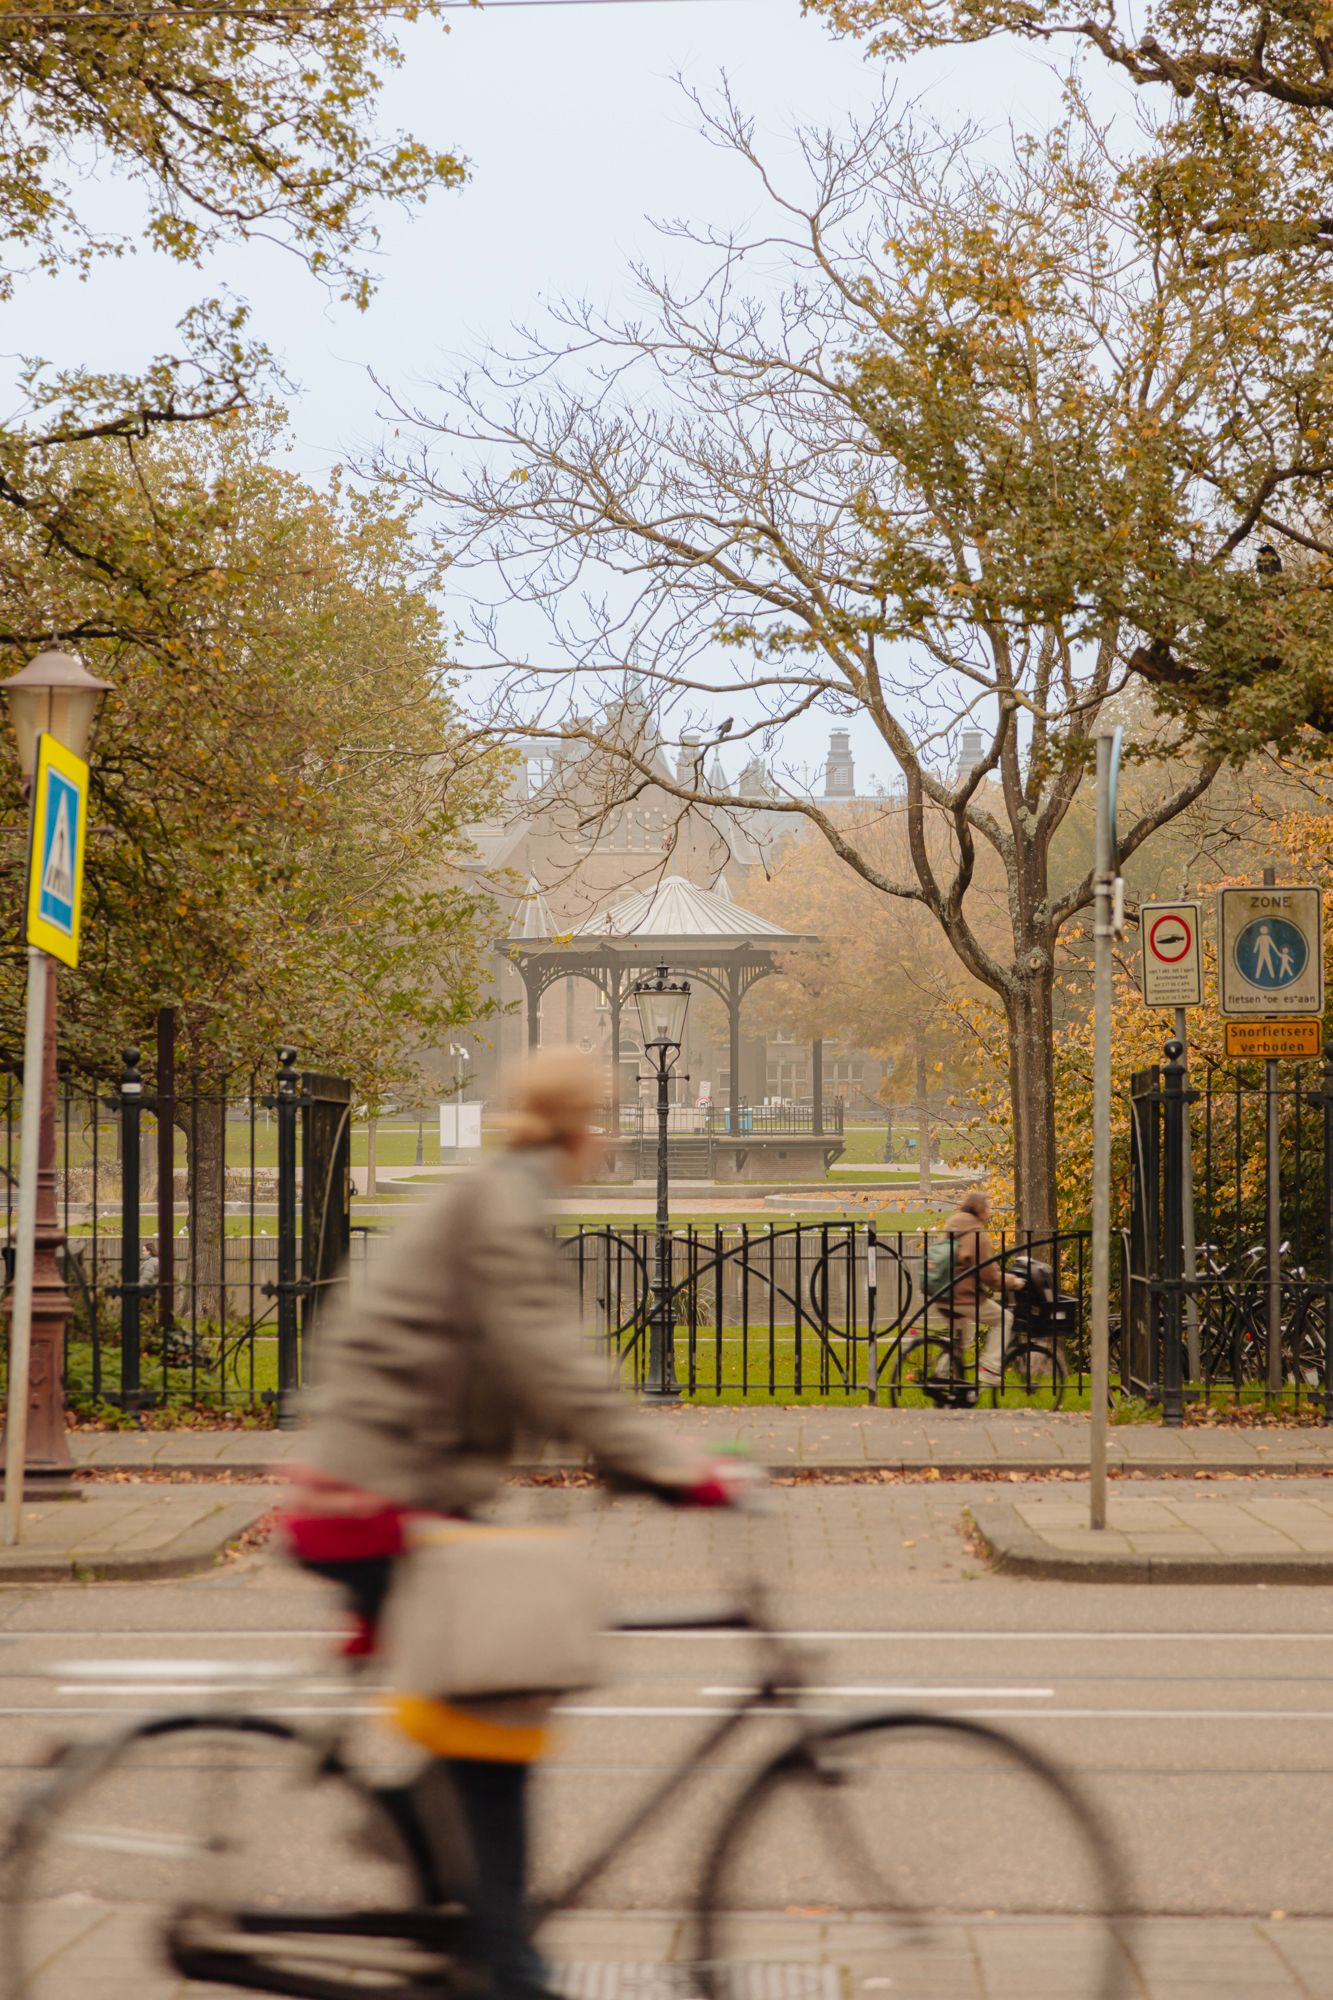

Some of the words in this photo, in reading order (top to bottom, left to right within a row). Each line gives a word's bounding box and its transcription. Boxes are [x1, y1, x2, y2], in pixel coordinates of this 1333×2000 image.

[1250, 896, 1292, 908] ZONE
[1228, 995, 1260, 1004] fietsen
[1230, 1026, 1314, 1037] Snorfietsers
[1240, 1042, 1304, 1052] verboden
